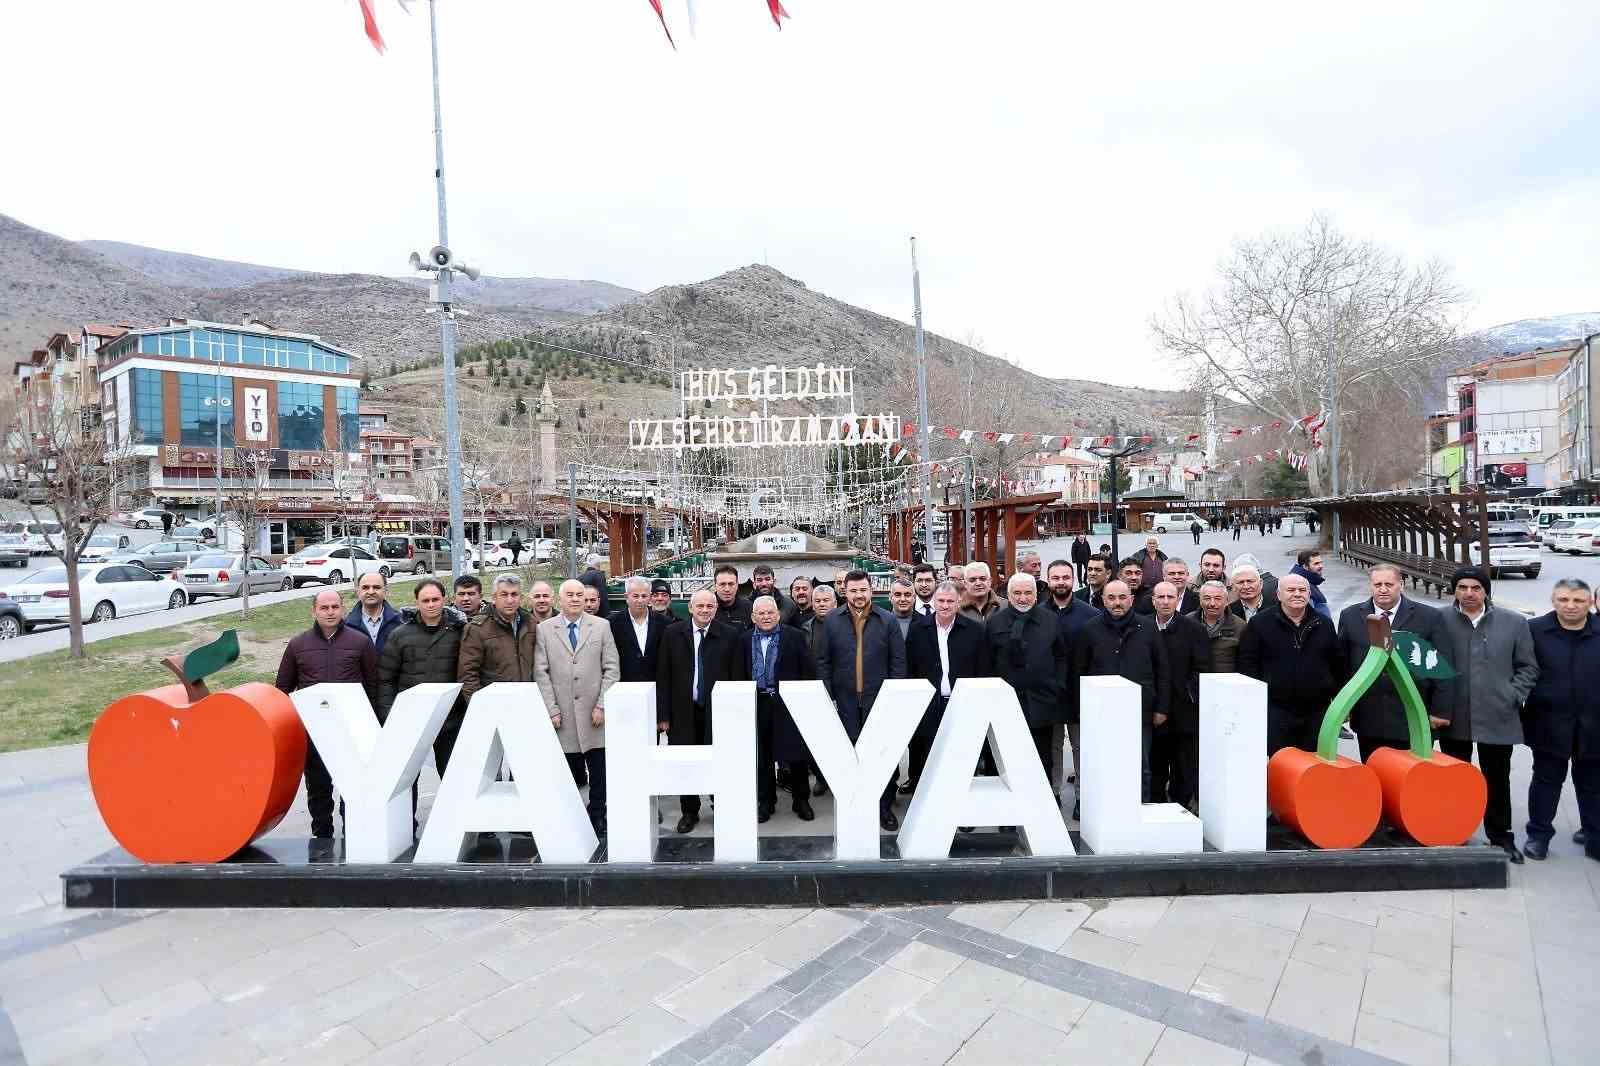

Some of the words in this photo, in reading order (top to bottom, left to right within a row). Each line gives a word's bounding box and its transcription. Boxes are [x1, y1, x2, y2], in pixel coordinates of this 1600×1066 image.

[689, 367, 738, 409] HOŞ
[748, 362, 846, 401] GELDİN
[251, 394, 263, 433] YTO
[290, 673, 1268, 864] YAHYALI
